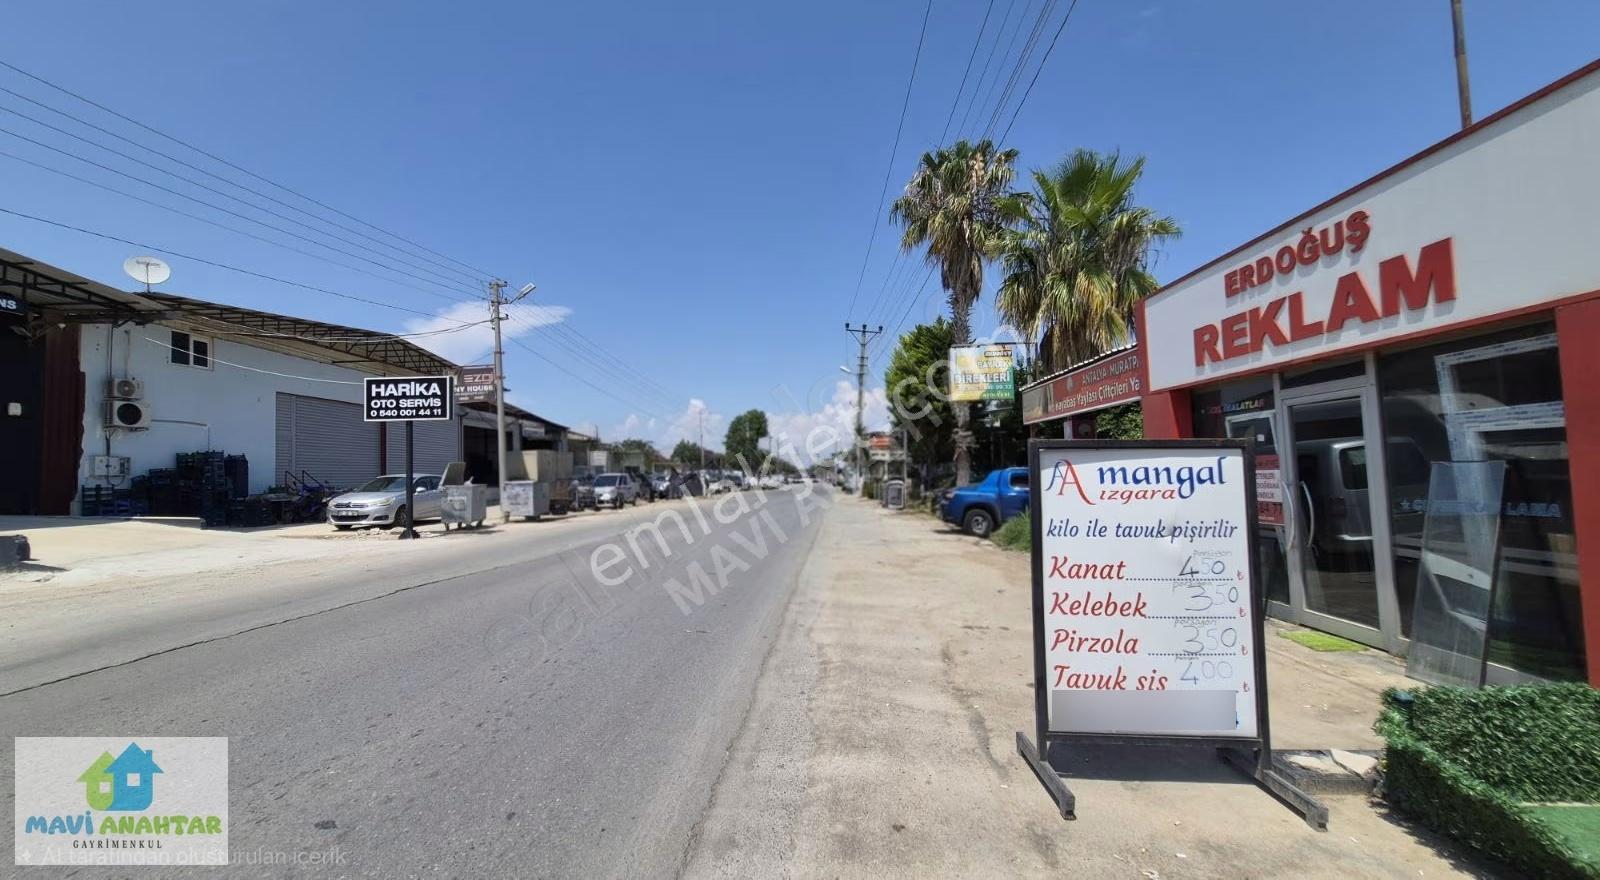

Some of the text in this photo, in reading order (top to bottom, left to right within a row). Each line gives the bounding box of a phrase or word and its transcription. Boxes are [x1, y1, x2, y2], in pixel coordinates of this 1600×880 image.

[1223, 209, 1371, 298] ERDOĞUŞ
[1192, 236, 1457, 367] REKLAM
[1082, 355, 1140, 385] ANTALYA MURATP
[371, 381, 441, 397] HARİKA
[1098, 380, 1129, 402] Çiftçileri
[370, 397, 441, 409] OTO SERVİS
[380, 409, 398, 417] 540
[399, 409, 416, 417] 001
[418, 408, 431, 416] 44
[433, 408, 441, 416] 11
[1097, 456, 1227, 500] mangal
[1047, 518, 1238, 543] kilo ile tavuk pişirilir
[1049, 555, 1126, 580] Kanat
[1049, 590, 1147, 618] Kelebek
[1050, 628, 1138, 655] Pirzola
[1053, 664, 1127, 691] Tavuk
